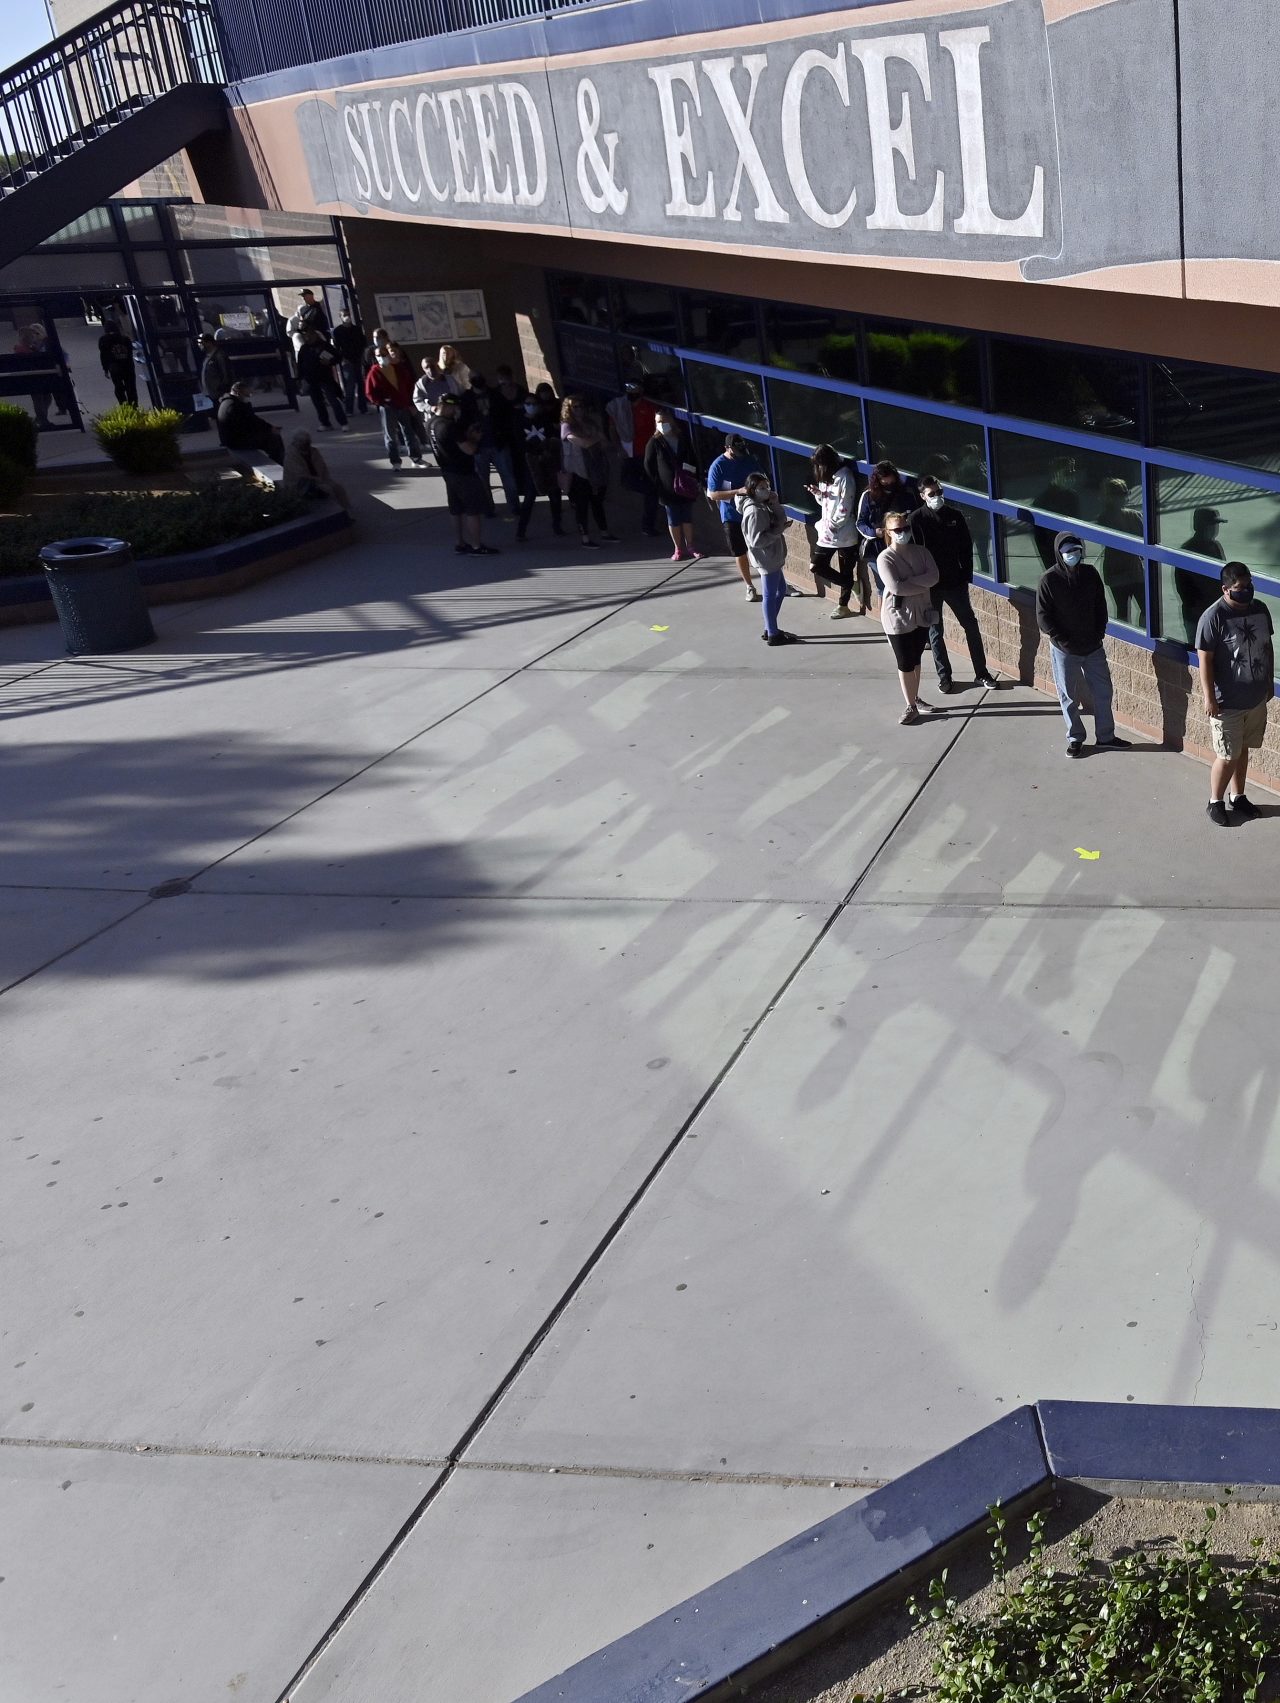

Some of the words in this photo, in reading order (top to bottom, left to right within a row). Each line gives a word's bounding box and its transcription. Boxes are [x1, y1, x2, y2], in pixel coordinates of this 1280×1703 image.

[342, 81, 550, 206] SUCCEED
[576, 77, 629, 216] &
[648, 25, 1045, 238] EXCEL
